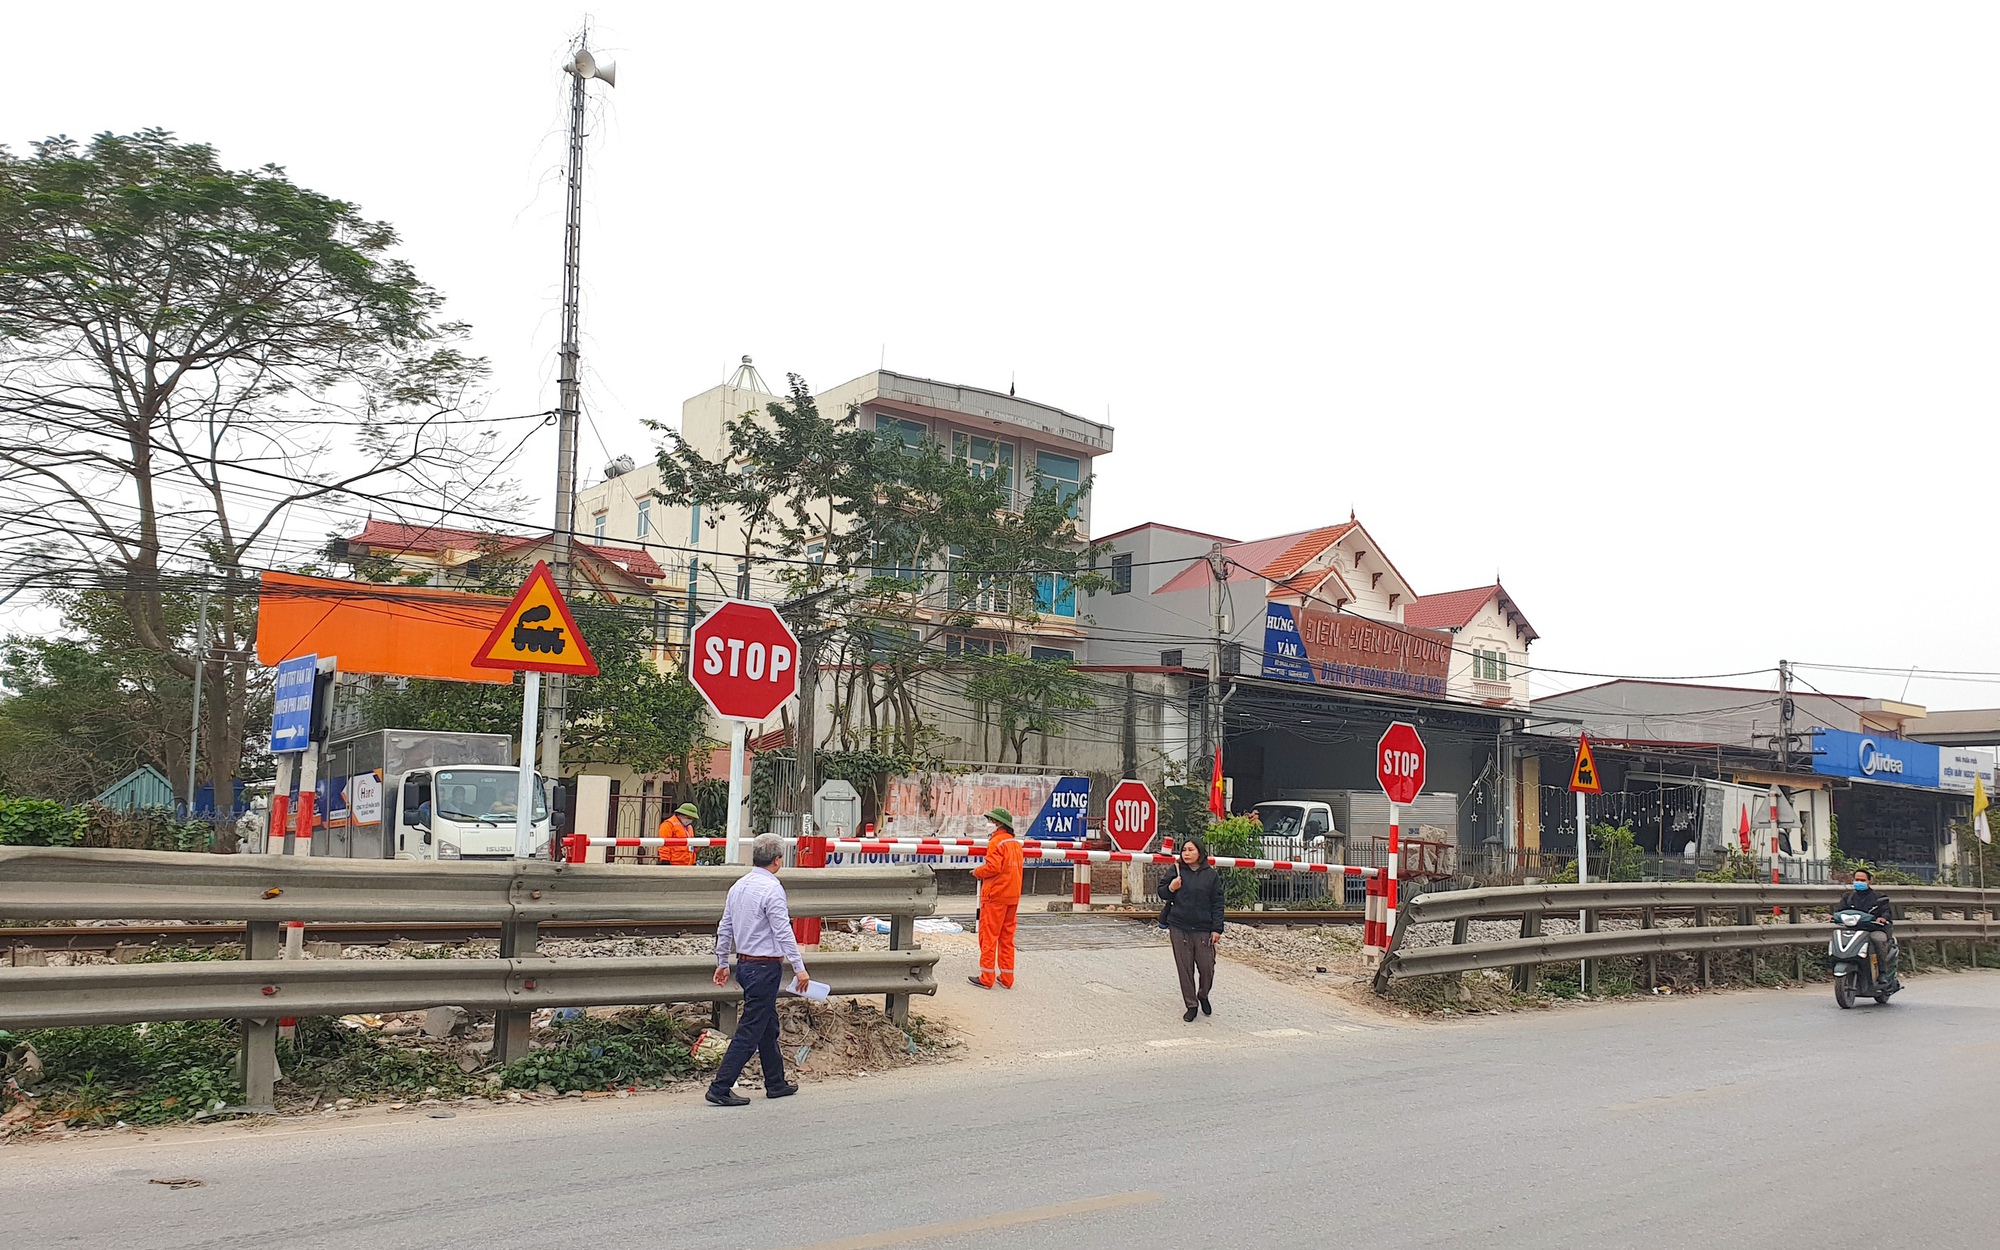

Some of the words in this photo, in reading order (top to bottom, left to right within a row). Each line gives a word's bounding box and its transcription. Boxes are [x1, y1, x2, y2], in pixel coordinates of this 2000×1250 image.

[1266, 615, 1294, 632] HƯNG
[703, 636, 791, 682] STOP
[1384, 749, 1419, 778] STOP
[1859, 739, 1903, 776] Midea
[1052, 790, 1088, 809] HƯNG
[1046, 812, 1073, 832] VÀN
[1114, 799, 1150, 833] STOP
